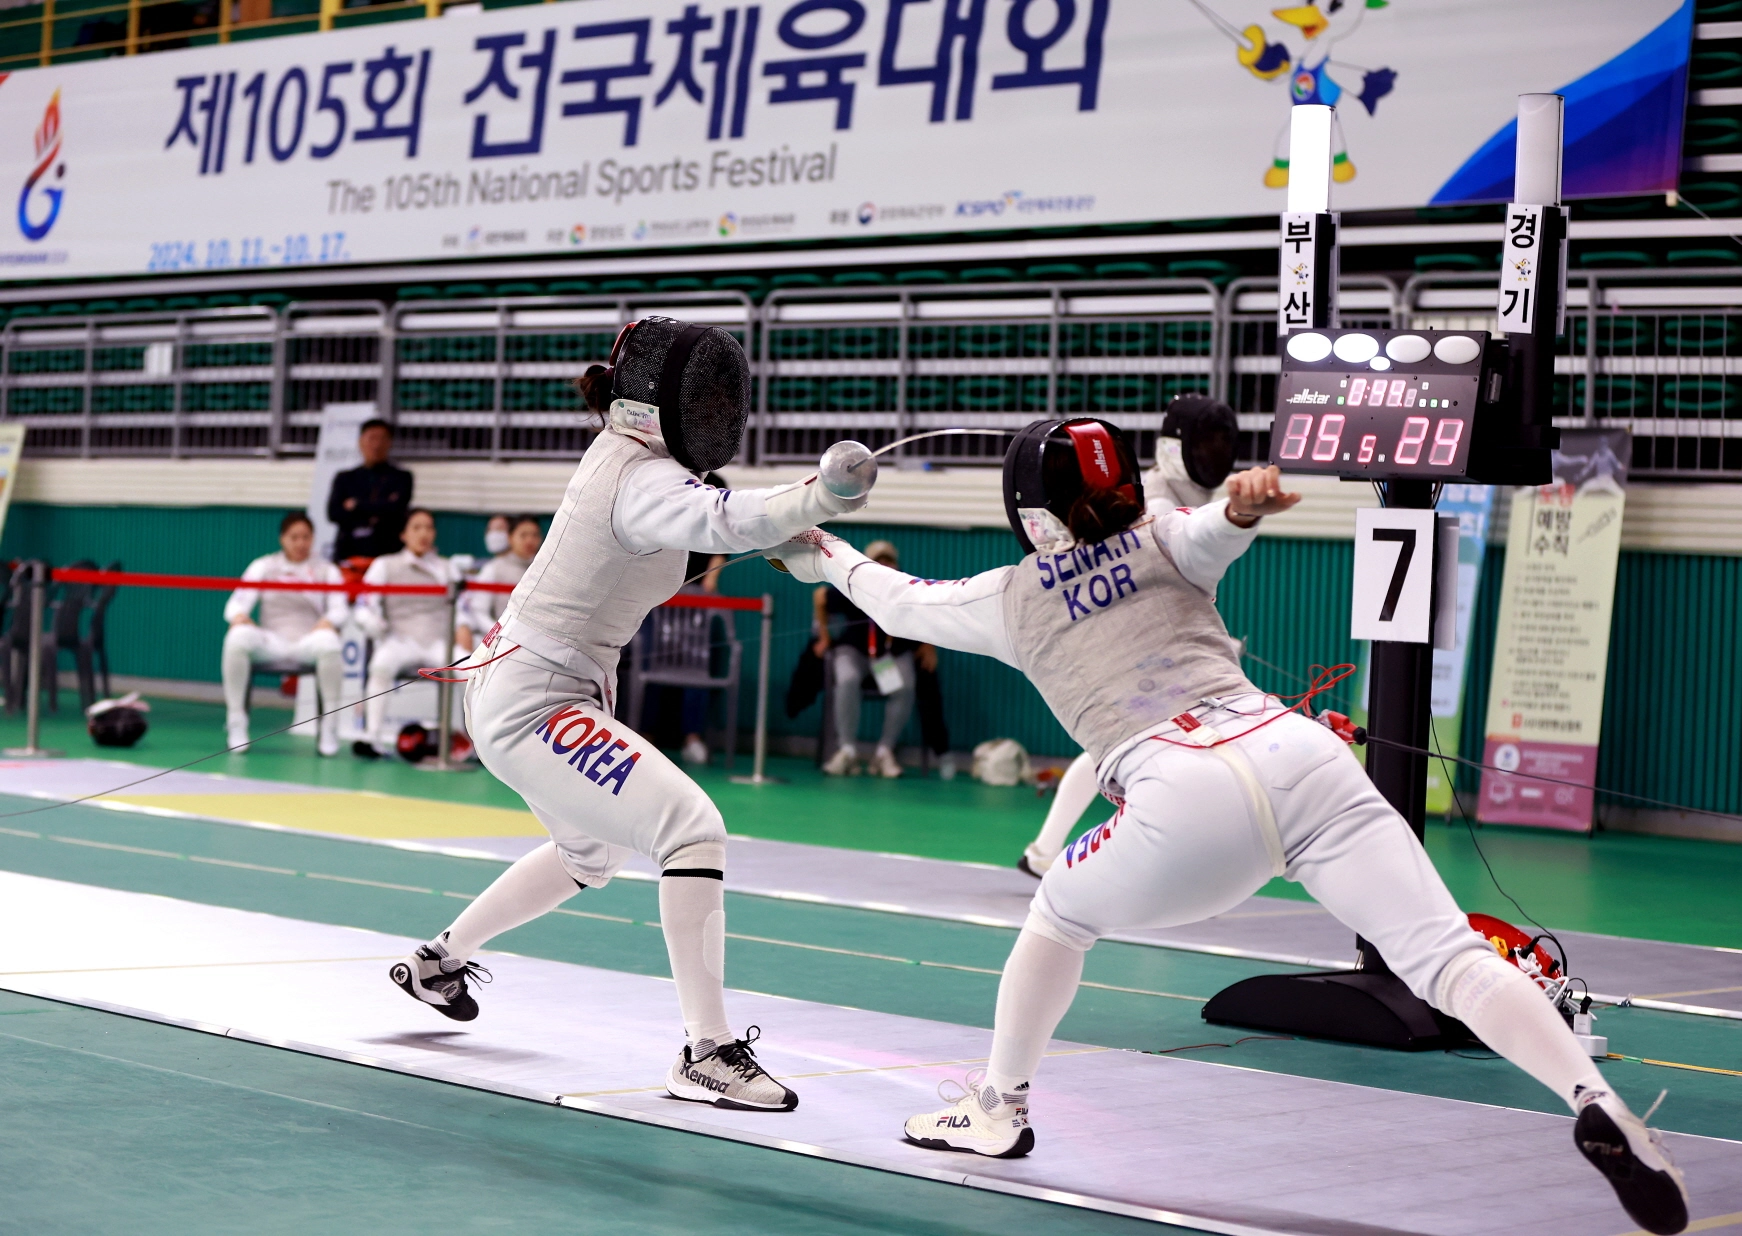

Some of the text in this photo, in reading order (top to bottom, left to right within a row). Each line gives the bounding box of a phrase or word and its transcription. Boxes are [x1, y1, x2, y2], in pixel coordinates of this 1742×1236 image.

[165, 45, 433, 175] 제105회
[327, 143, 838, 214] The 105th National Sports Festival
[1291, 388, 1332, 405] allstar
[1092, 438, 1110, 475] allstar
[1062, 563, 1138, 622] KOR
[1372, 528, 1417, 622] 7
[535, 705, 642, 797] KOREA
[679, 1061, 731, 1094] Kempa
[936, 1114, 971, 1128] FILA
